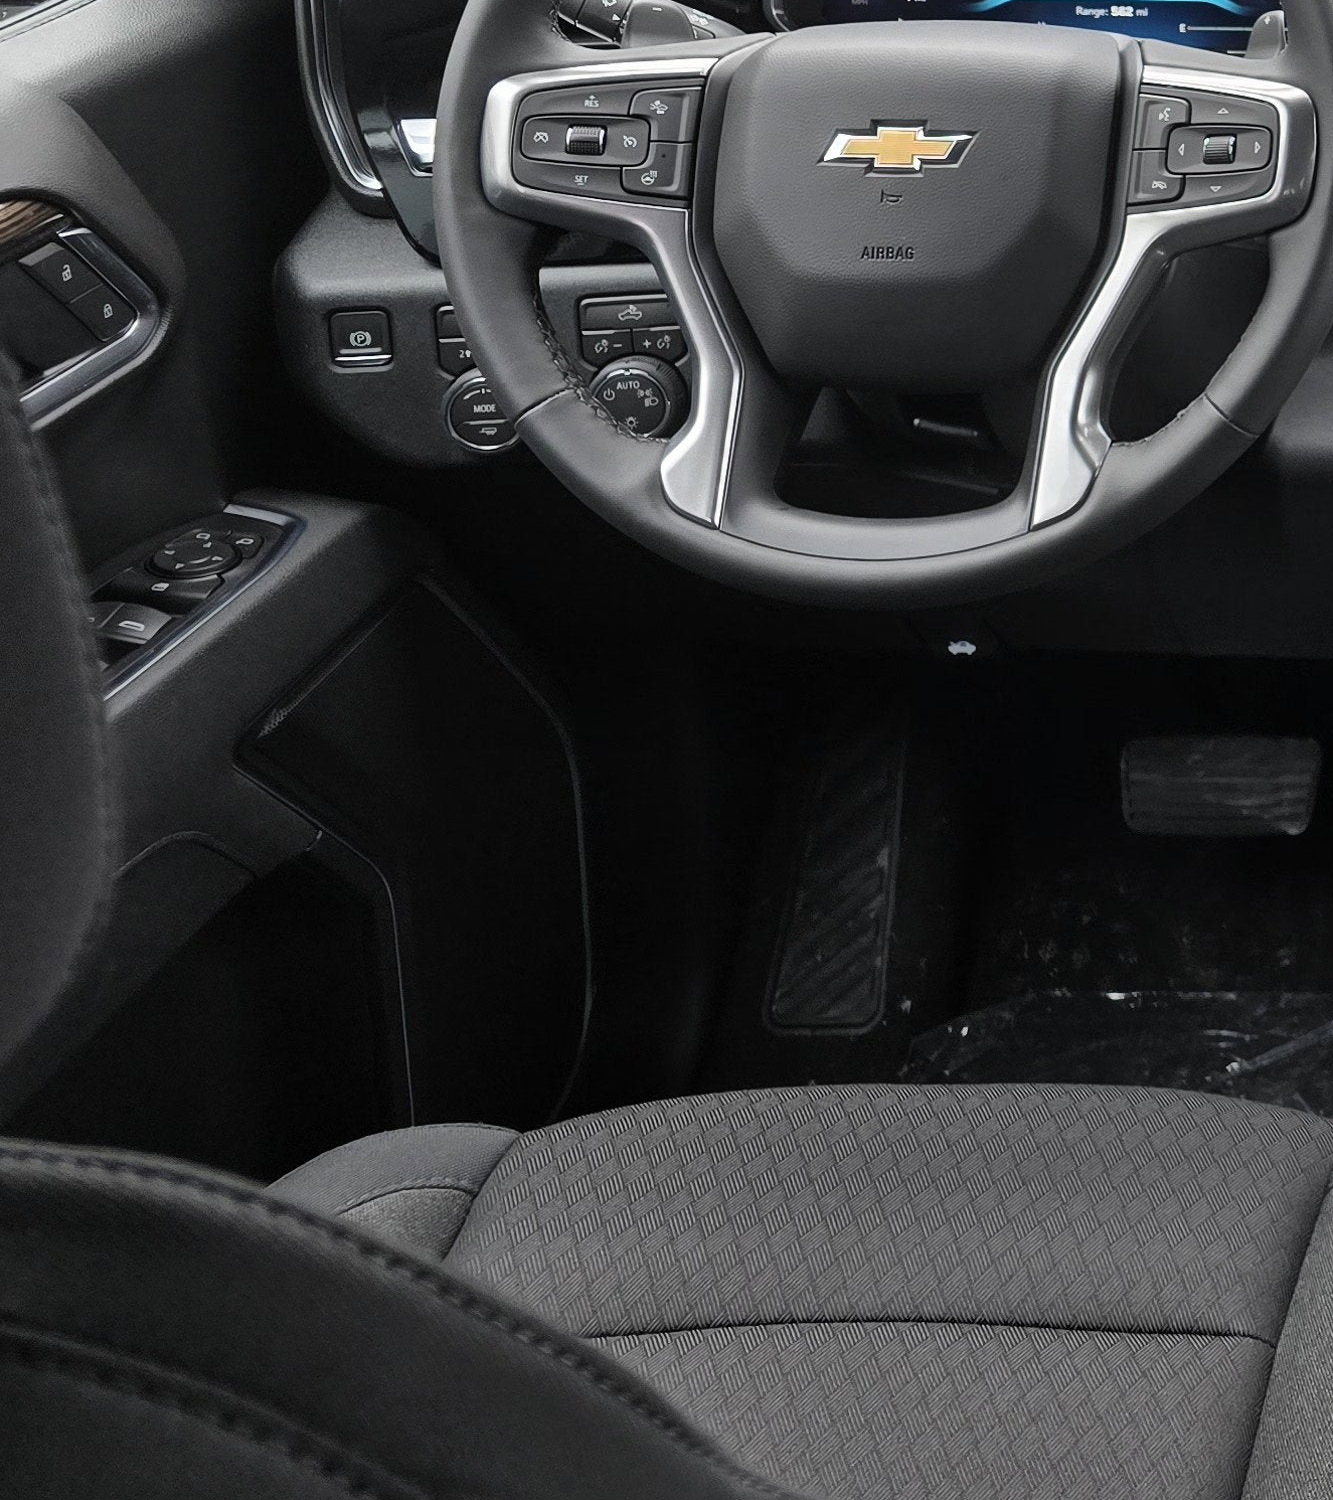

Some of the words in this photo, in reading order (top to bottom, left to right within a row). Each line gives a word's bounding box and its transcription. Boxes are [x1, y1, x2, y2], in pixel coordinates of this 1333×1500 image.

[1075, 5, 1109, 18] Range:
[1135, 6, 1149, 17] mi
[584, 99, 599, 108] RES
[574, 175, 588, 184] SET
[860, 244, 916, 262] AIRBAG
[616, 380, 641, 392] AUTO
[473, 403, 497, 414] MODE
